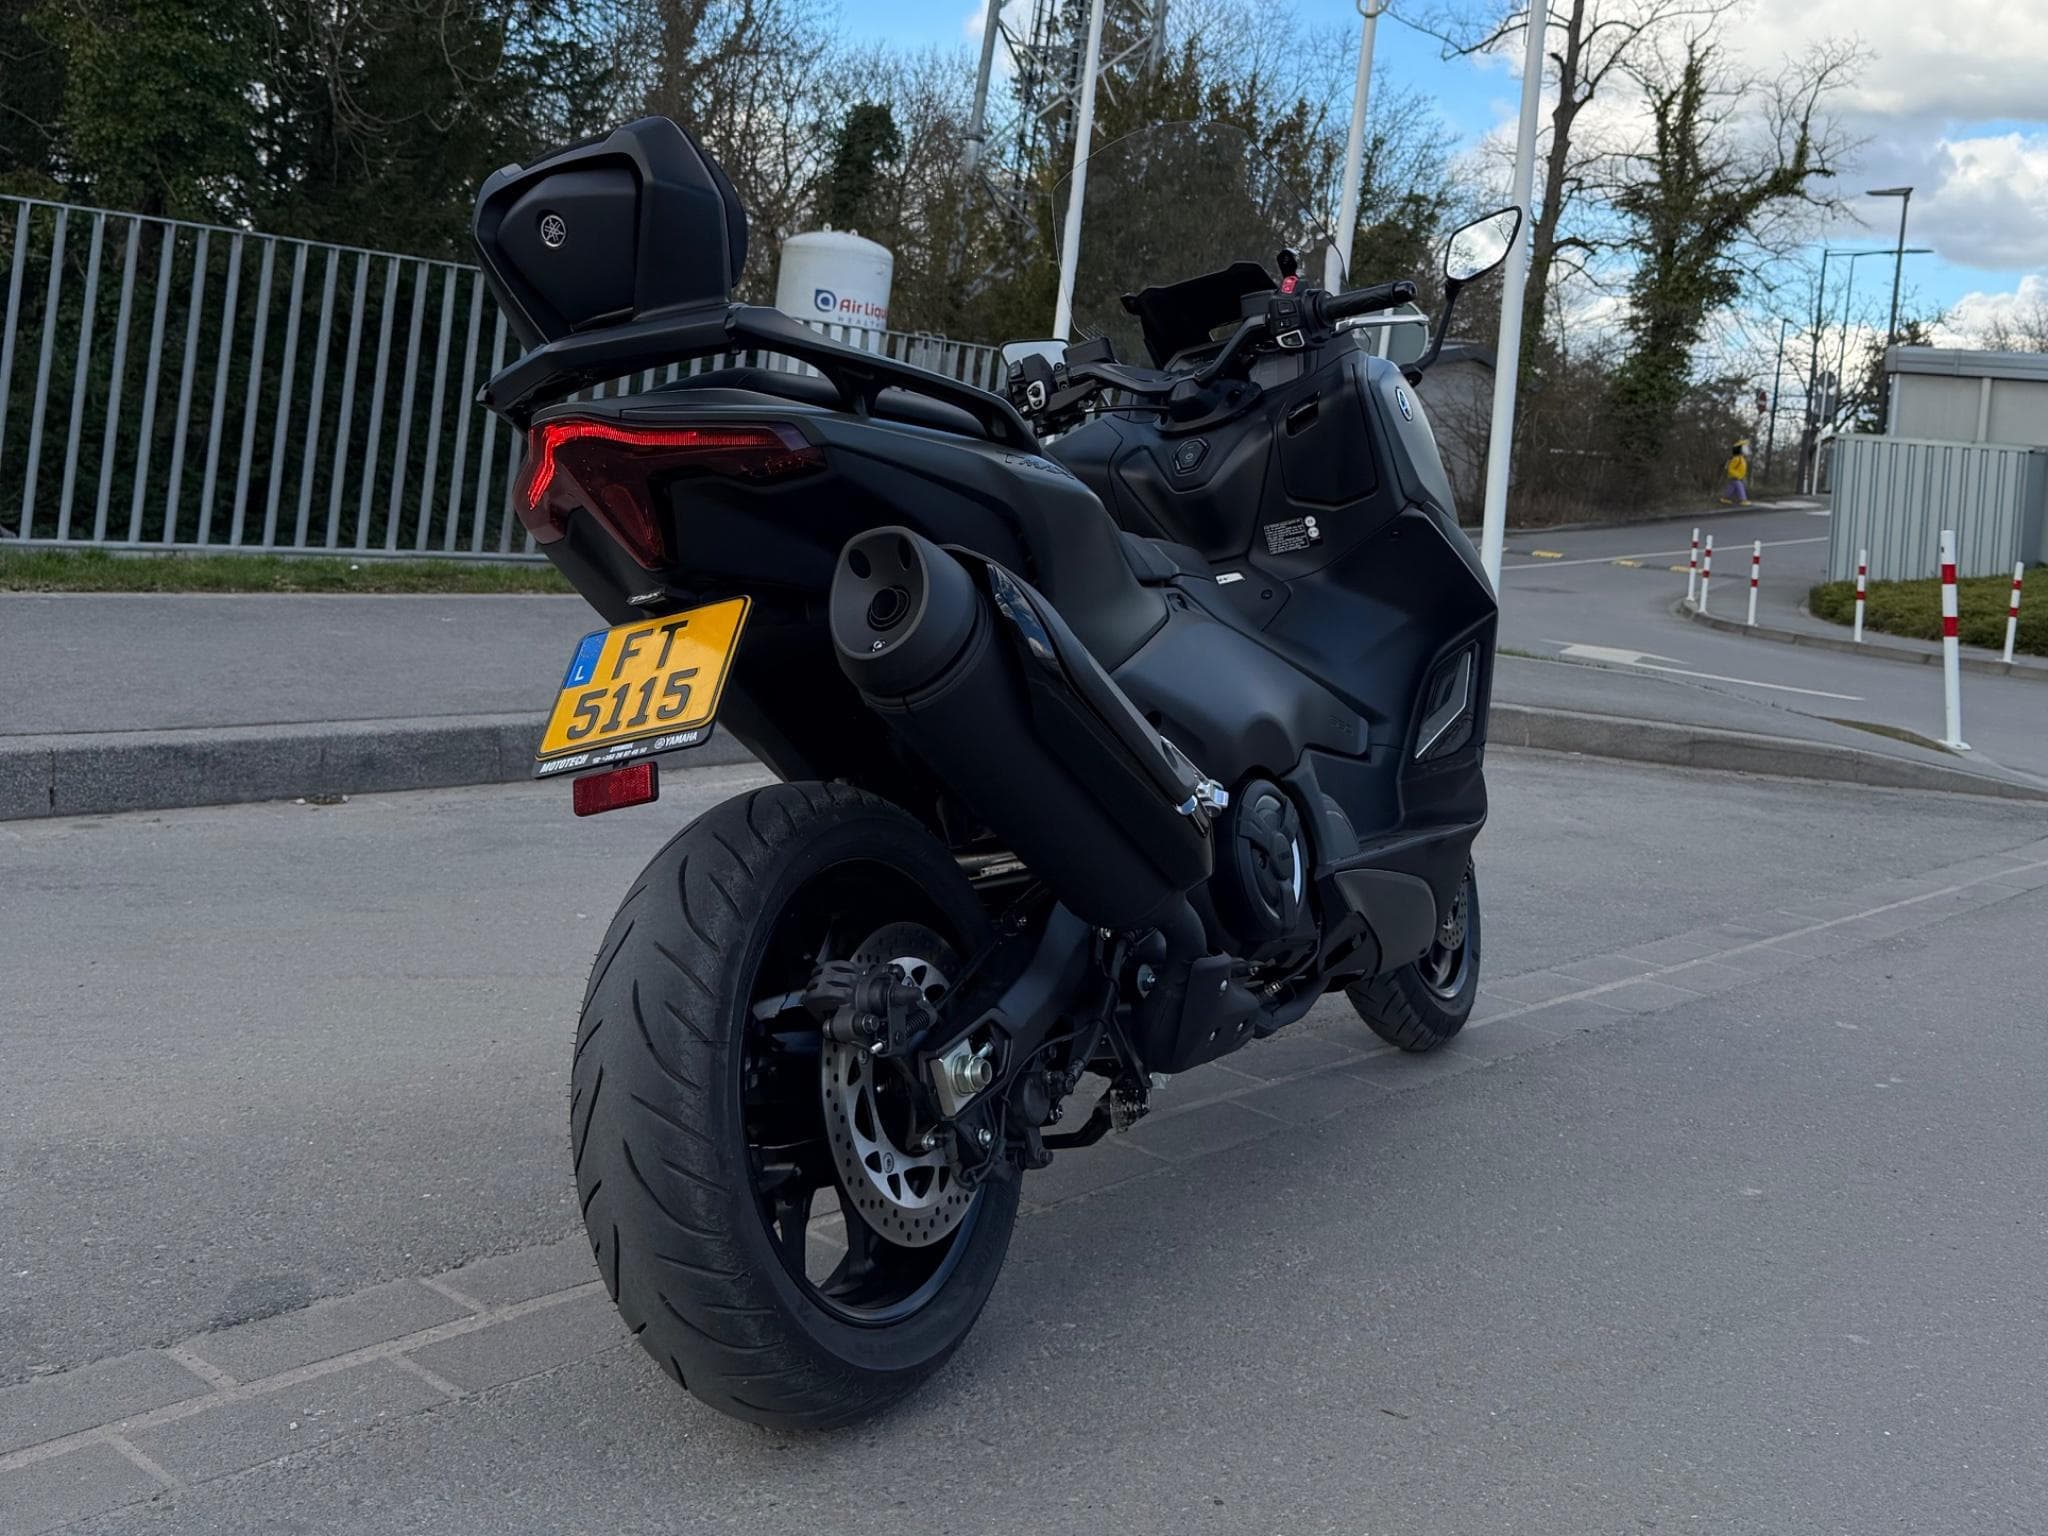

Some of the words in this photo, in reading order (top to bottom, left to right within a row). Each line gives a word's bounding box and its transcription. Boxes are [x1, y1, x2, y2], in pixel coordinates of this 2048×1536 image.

[840, 299, 862, 314] Air
[611, 620, 689, 680] FT
[575, 666, 584, 681] L
[566, 667, 698, 740] 5115
[664, 731, 698, 748] YAMAHA
[539, 753, 589, 774] MOTOTECH
